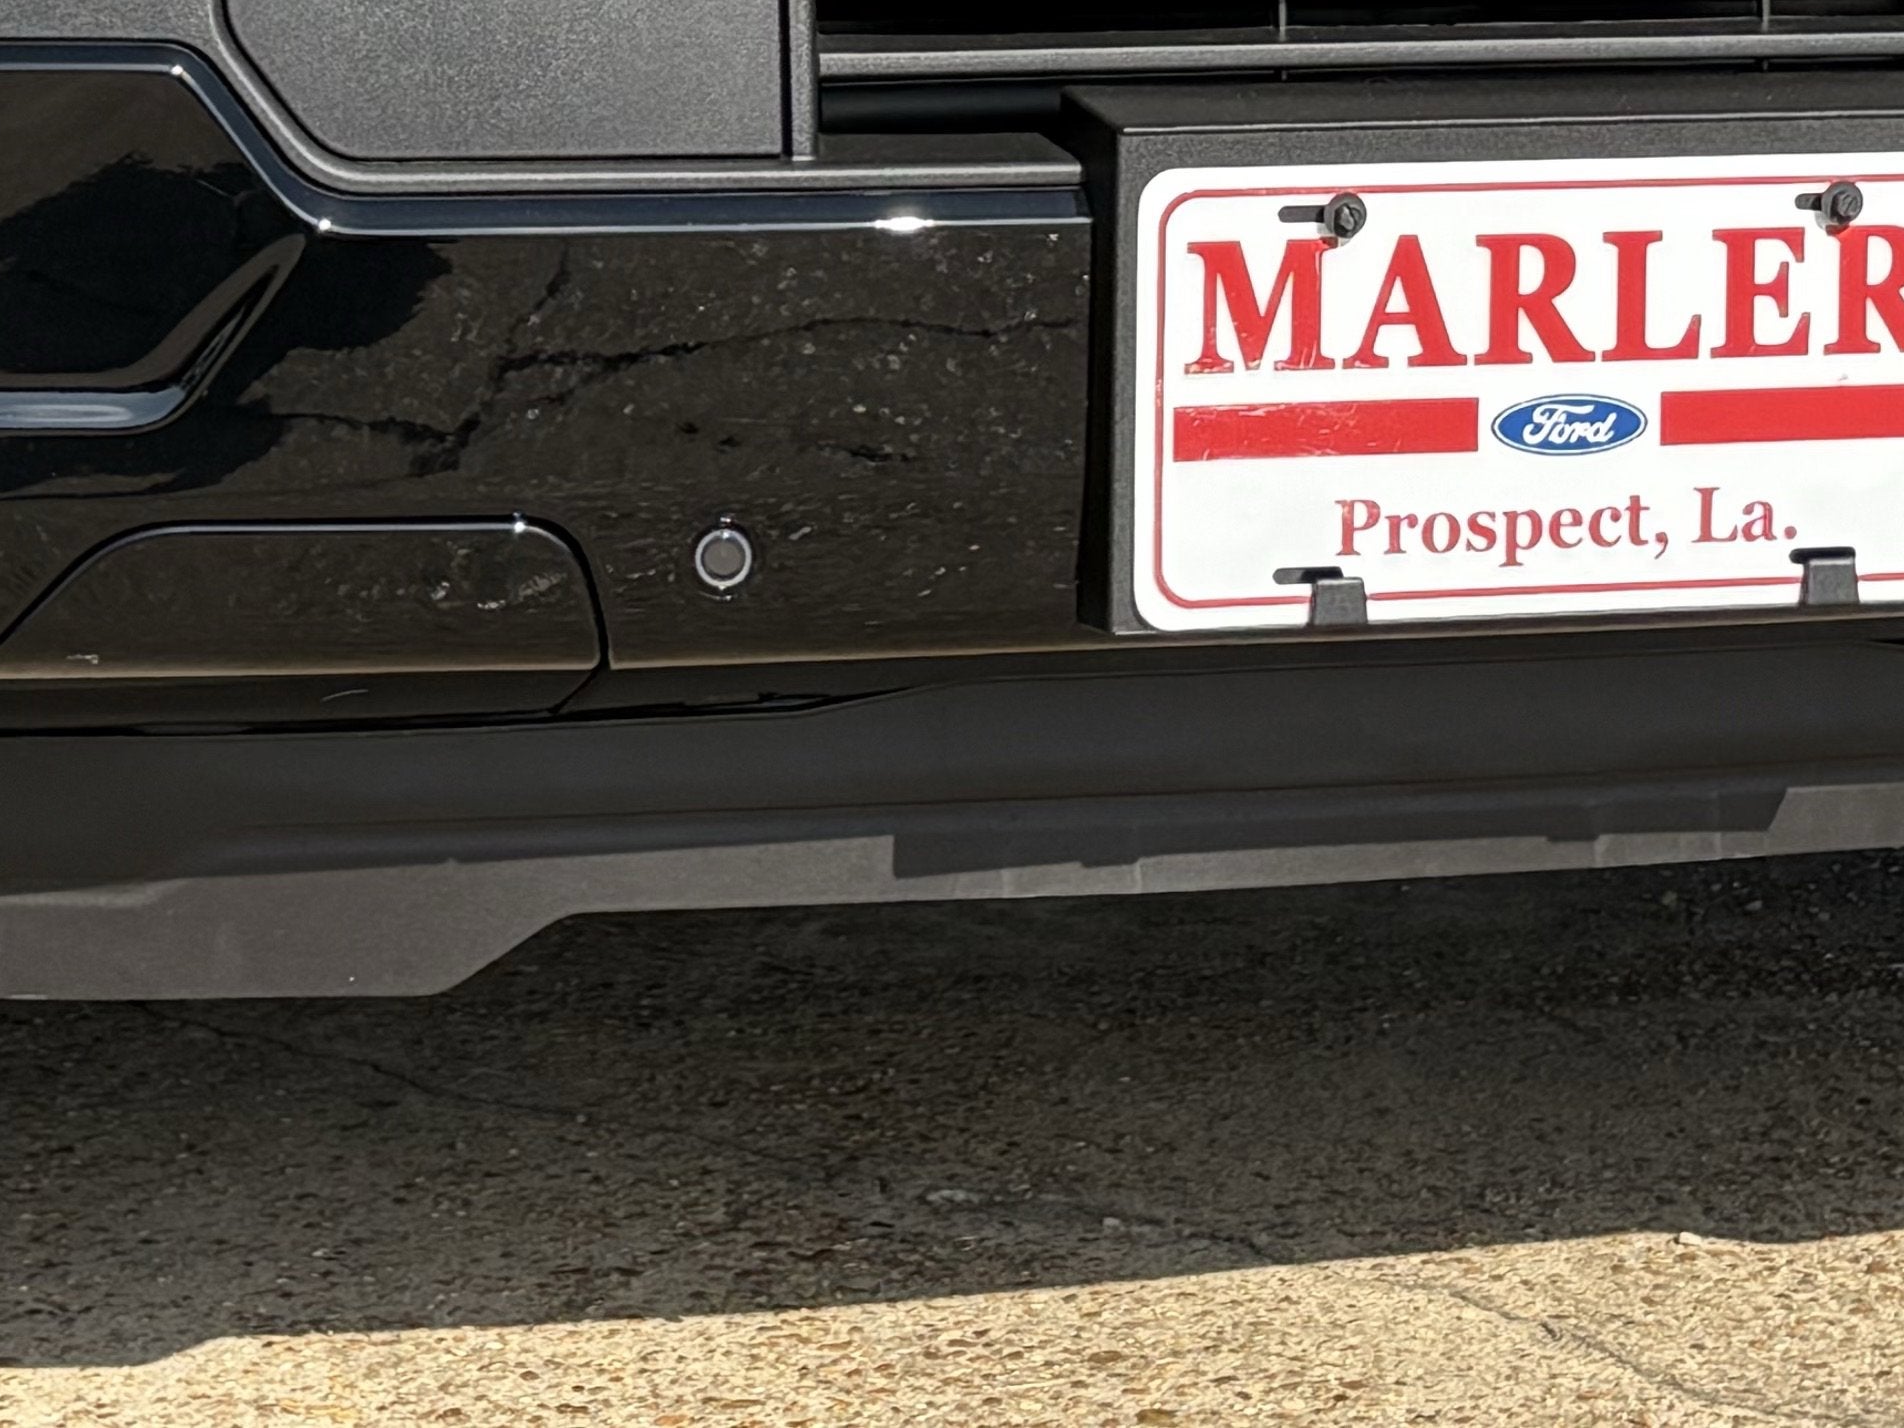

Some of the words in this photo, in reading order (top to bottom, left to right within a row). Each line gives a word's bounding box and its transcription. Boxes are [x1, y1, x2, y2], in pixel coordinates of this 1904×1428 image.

[1521, 403, 1619, 445] Ford
[1335, 494, 1669, 567] Prospect,
[1691, 486, 1798, 544] La.
